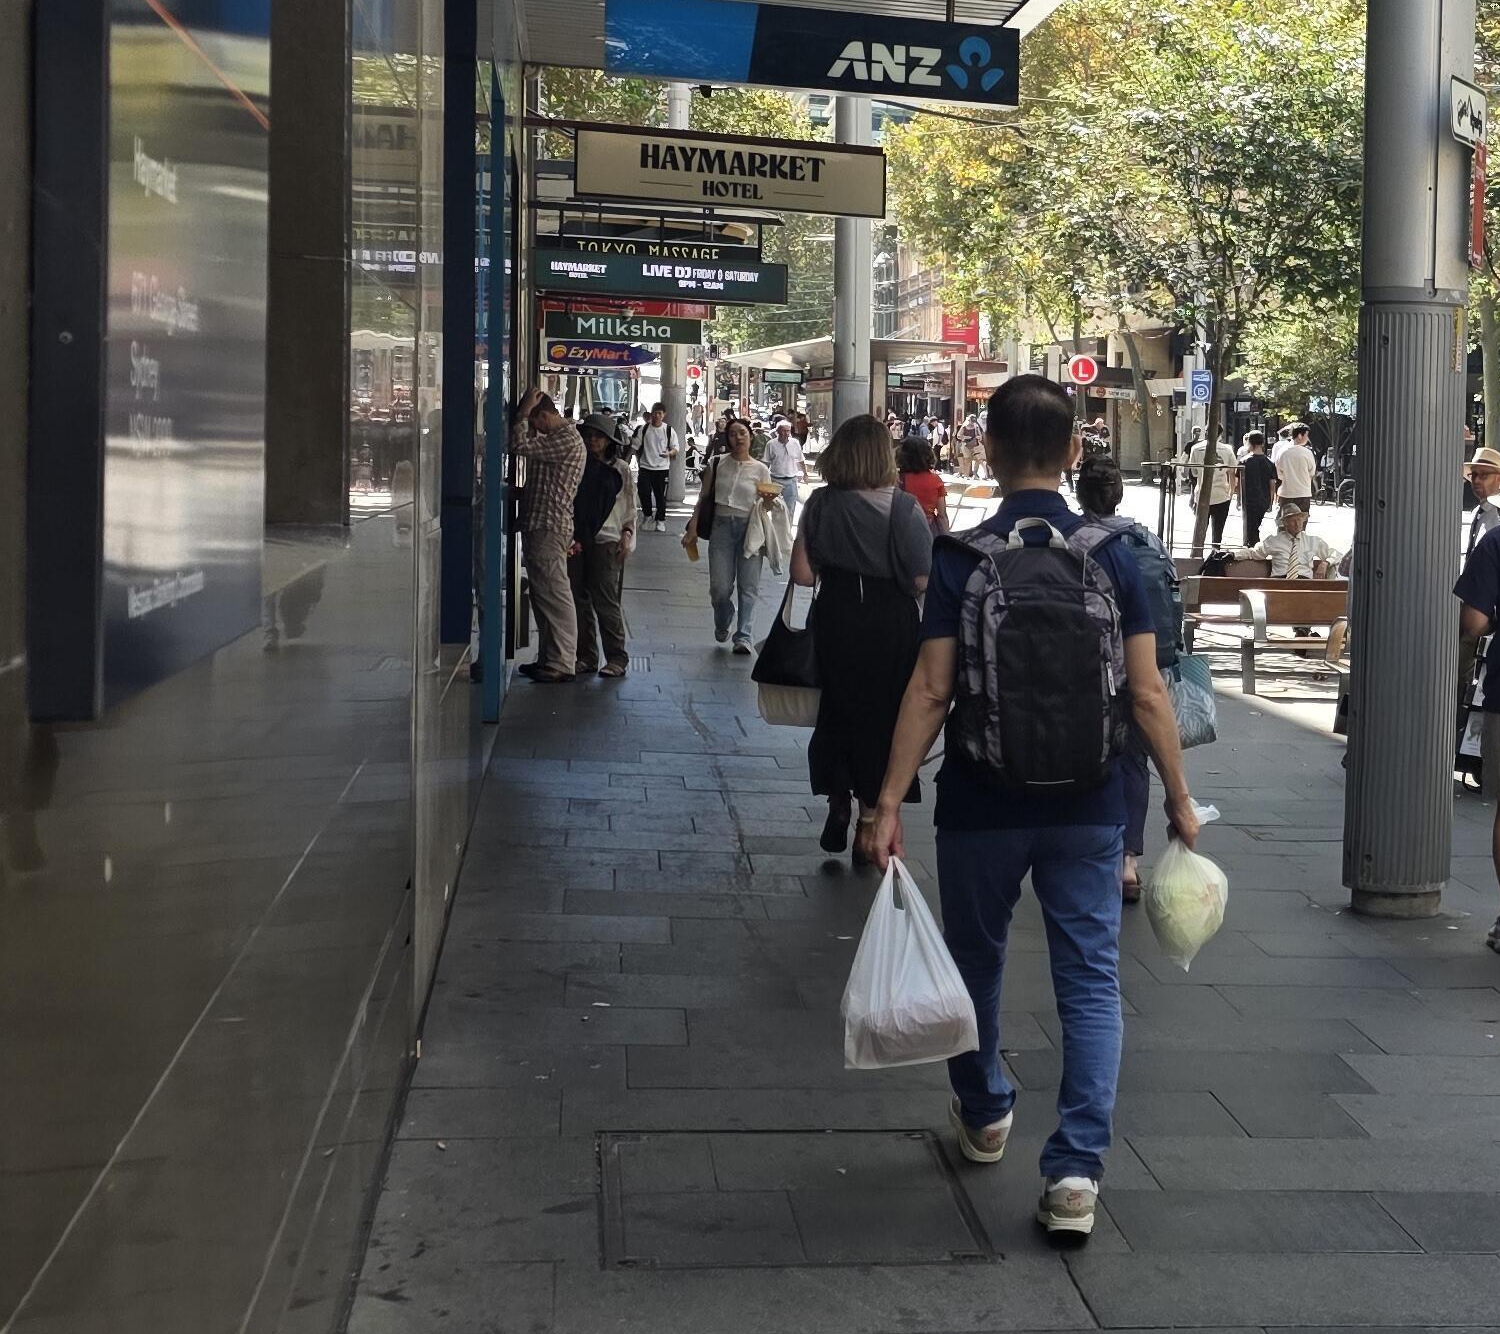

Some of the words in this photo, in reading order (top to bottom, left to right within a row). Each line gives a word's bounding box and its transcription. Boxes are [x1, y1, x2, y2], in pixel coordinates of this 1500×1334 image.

[827, 40, 942, 86] ANZ
[640, 143, 826, 183] HAYMARKET
[702, 180, 763, 200] HOTEL
[551, 261, 607, 274] HAYMARKET
[642, 264, 673, 277] LIVE
[675, 266, 691, 279] DJ
[692, 269, 716, 280] FRIDAY
[725, 271, 759, 283] SATURDAY
[577, 317, 671, 338] Milksha
